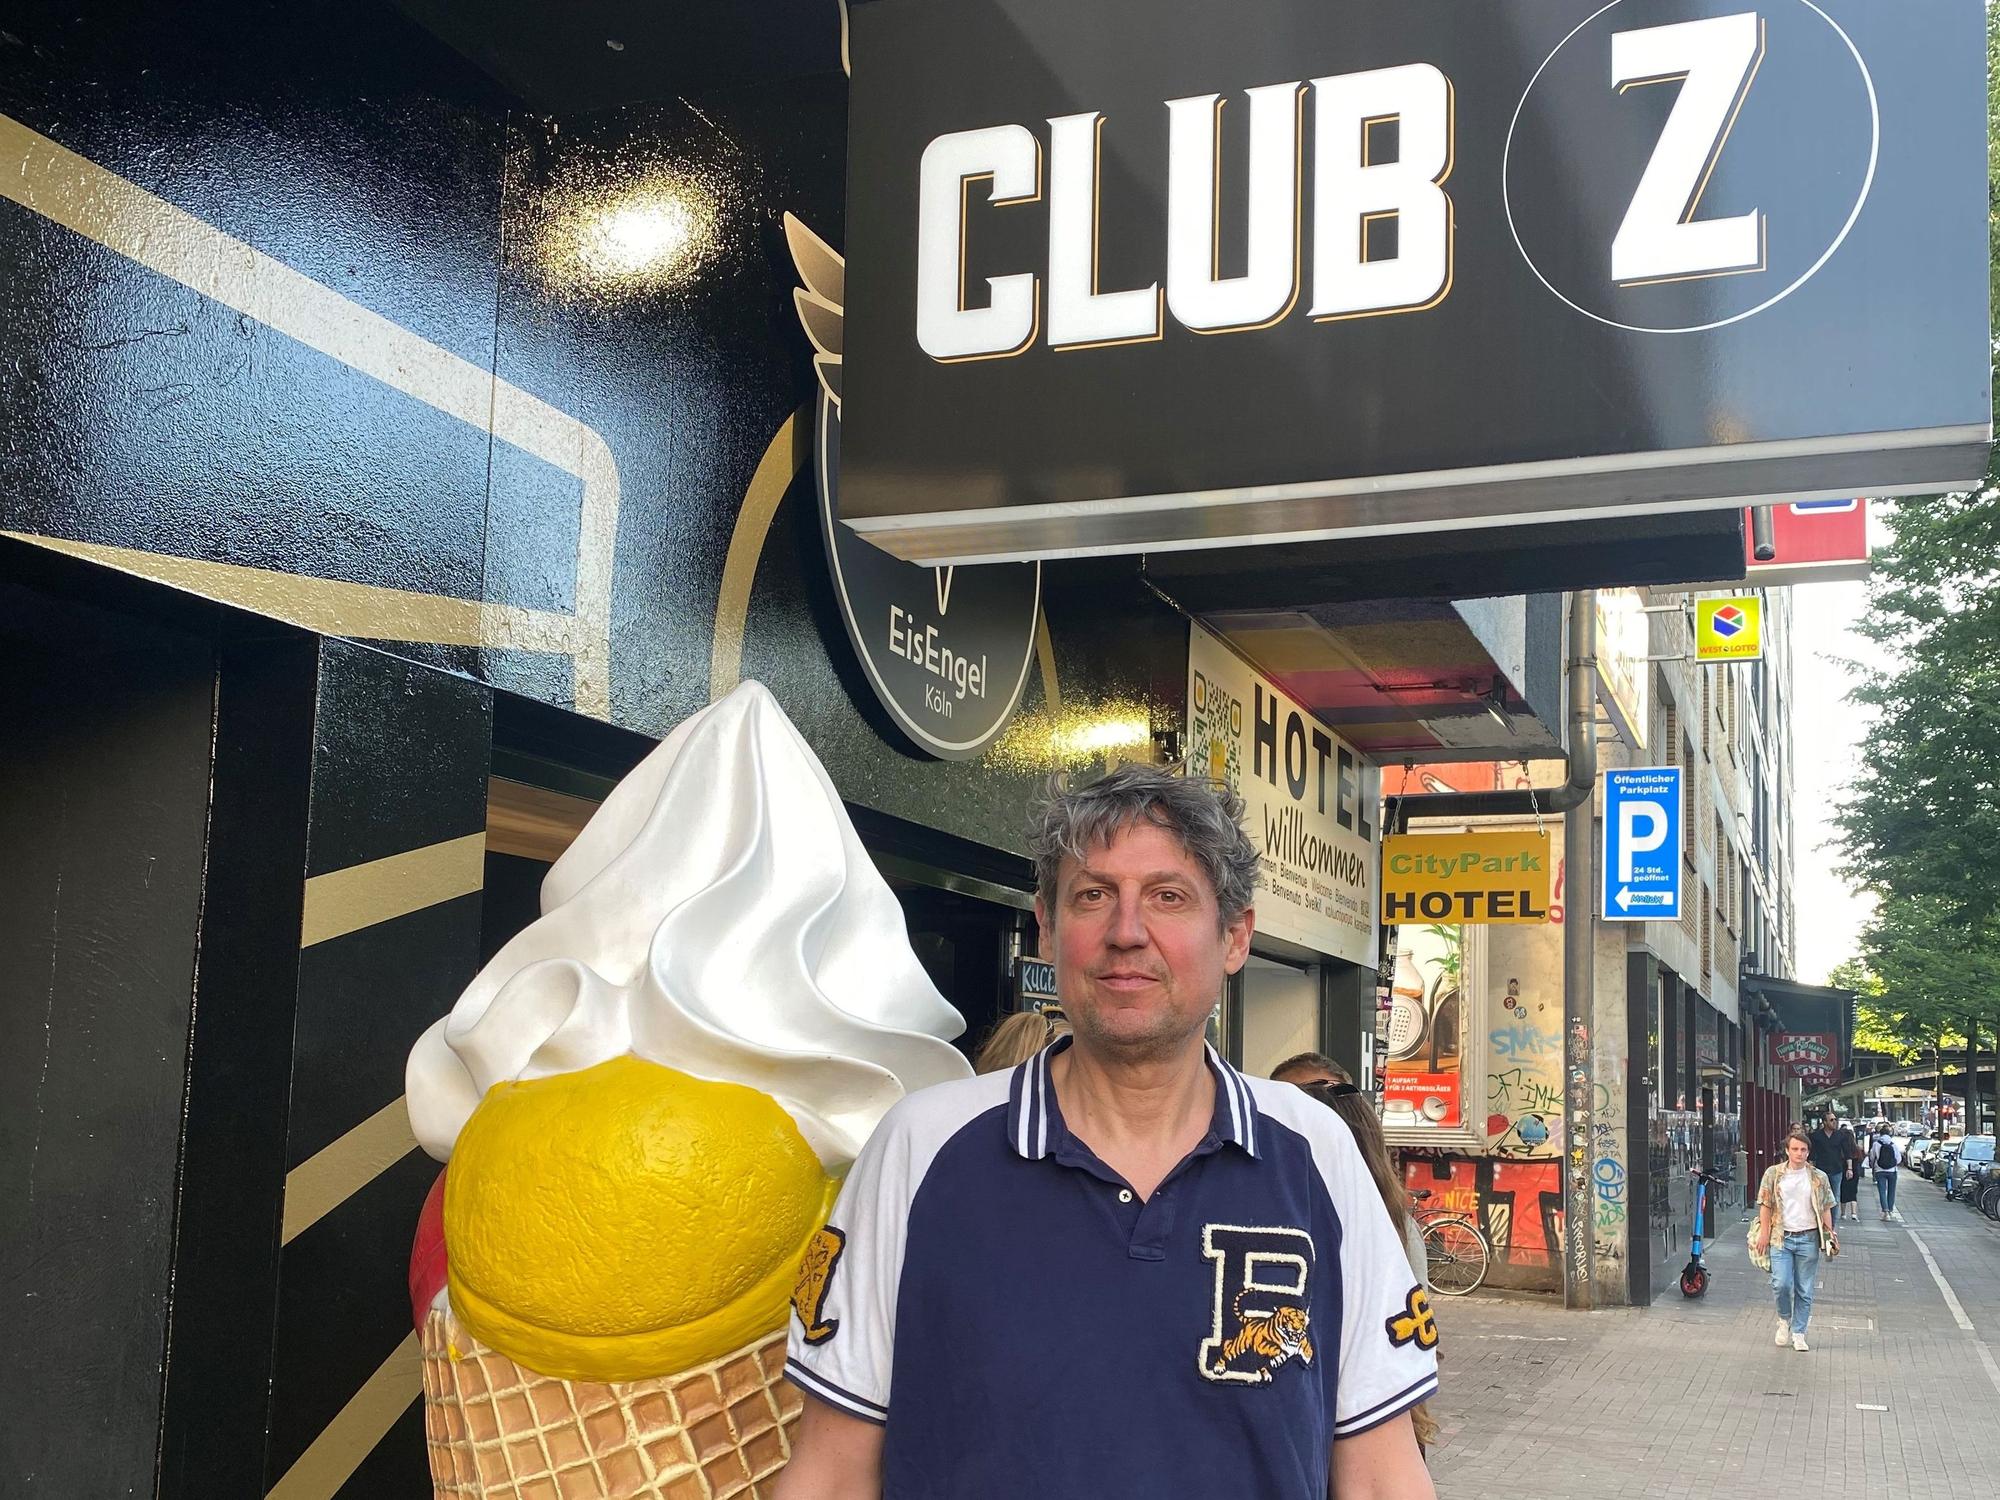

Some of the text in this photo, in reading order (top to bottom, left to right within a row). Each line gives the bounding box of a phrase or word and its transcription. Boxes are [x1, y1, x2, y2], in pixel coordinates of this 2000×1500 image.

[917, 11, 1766, 364] CLUB Z
[889, 604, 986, 700] EisEngel
[1700, 644, 1757, 653] WEST LOTTO
[925, 683, 952, 719] Köln
[1254, 682, 1370, 842] HOTEL
[1614, 774, 1675, 785] Öffentlicher
[1619, 785, 1669, 795] Parkplatz
[1264, 803, 1365, 888] Willkommen
[1618, 800, 1668, 883] P
[1390, 851, 1541, 878] CityPark
[1633, 866, 1664, 874] 24 Std.
[1633, 874, 1669, 883] geöffnet
[1385, 890, 1546, 919] HOTEL
[1445, 1190, 1480, 1210] NICE
